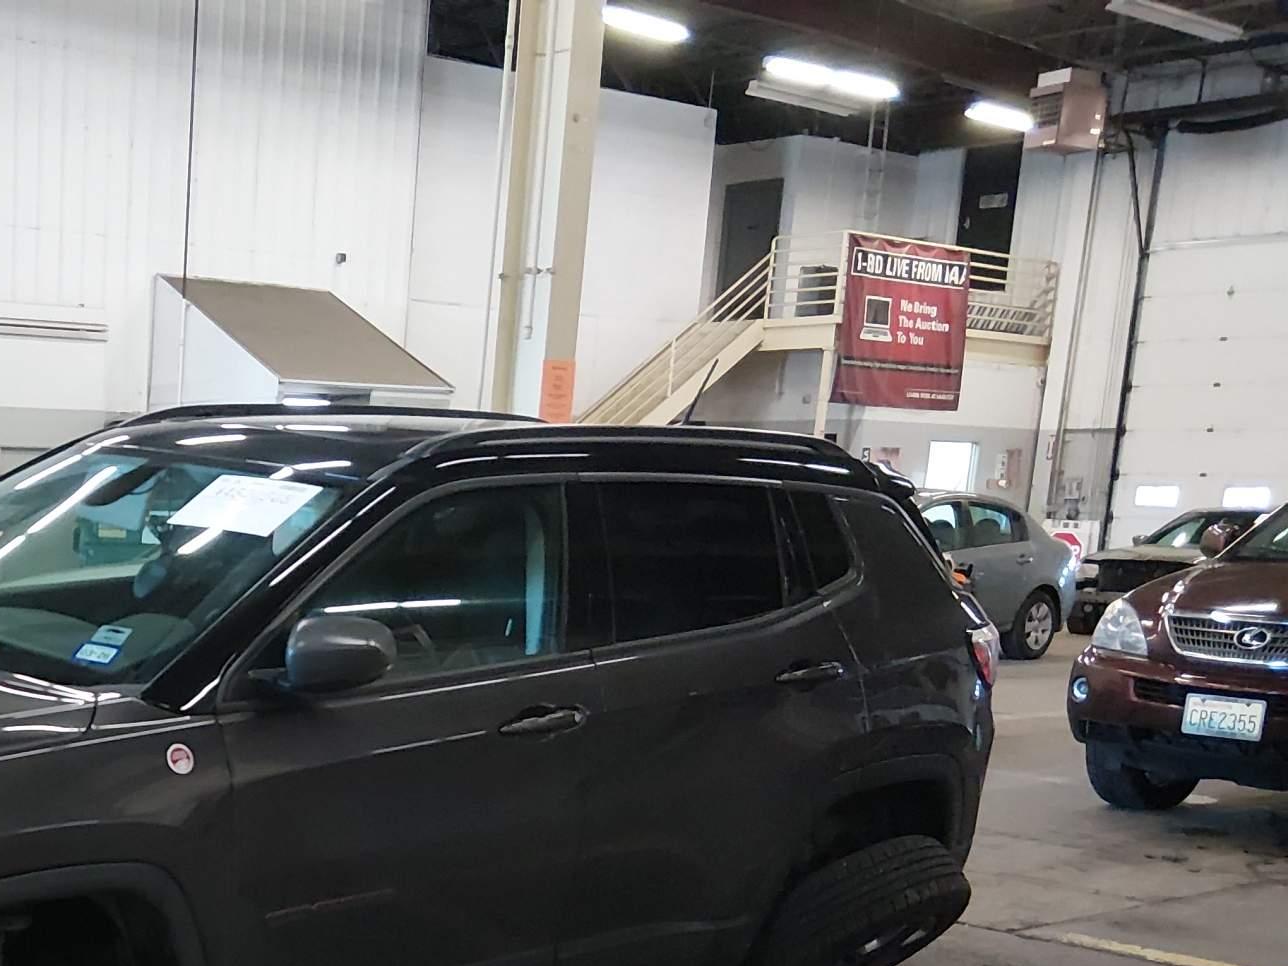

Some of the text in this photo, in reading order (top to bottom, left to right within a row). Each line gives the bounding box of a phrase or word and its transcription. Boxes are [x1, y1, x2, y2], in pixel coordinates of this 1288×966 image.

[885, 256, 909, 278] LIVE
[911, 260, 942, 283] FROM
[914, 301, 938, 318] Bring
[898, 315, 950, 332] The Auction
[896, 331, 924, 345] To You
[1189, 708, 1257, 733] CRE2355
